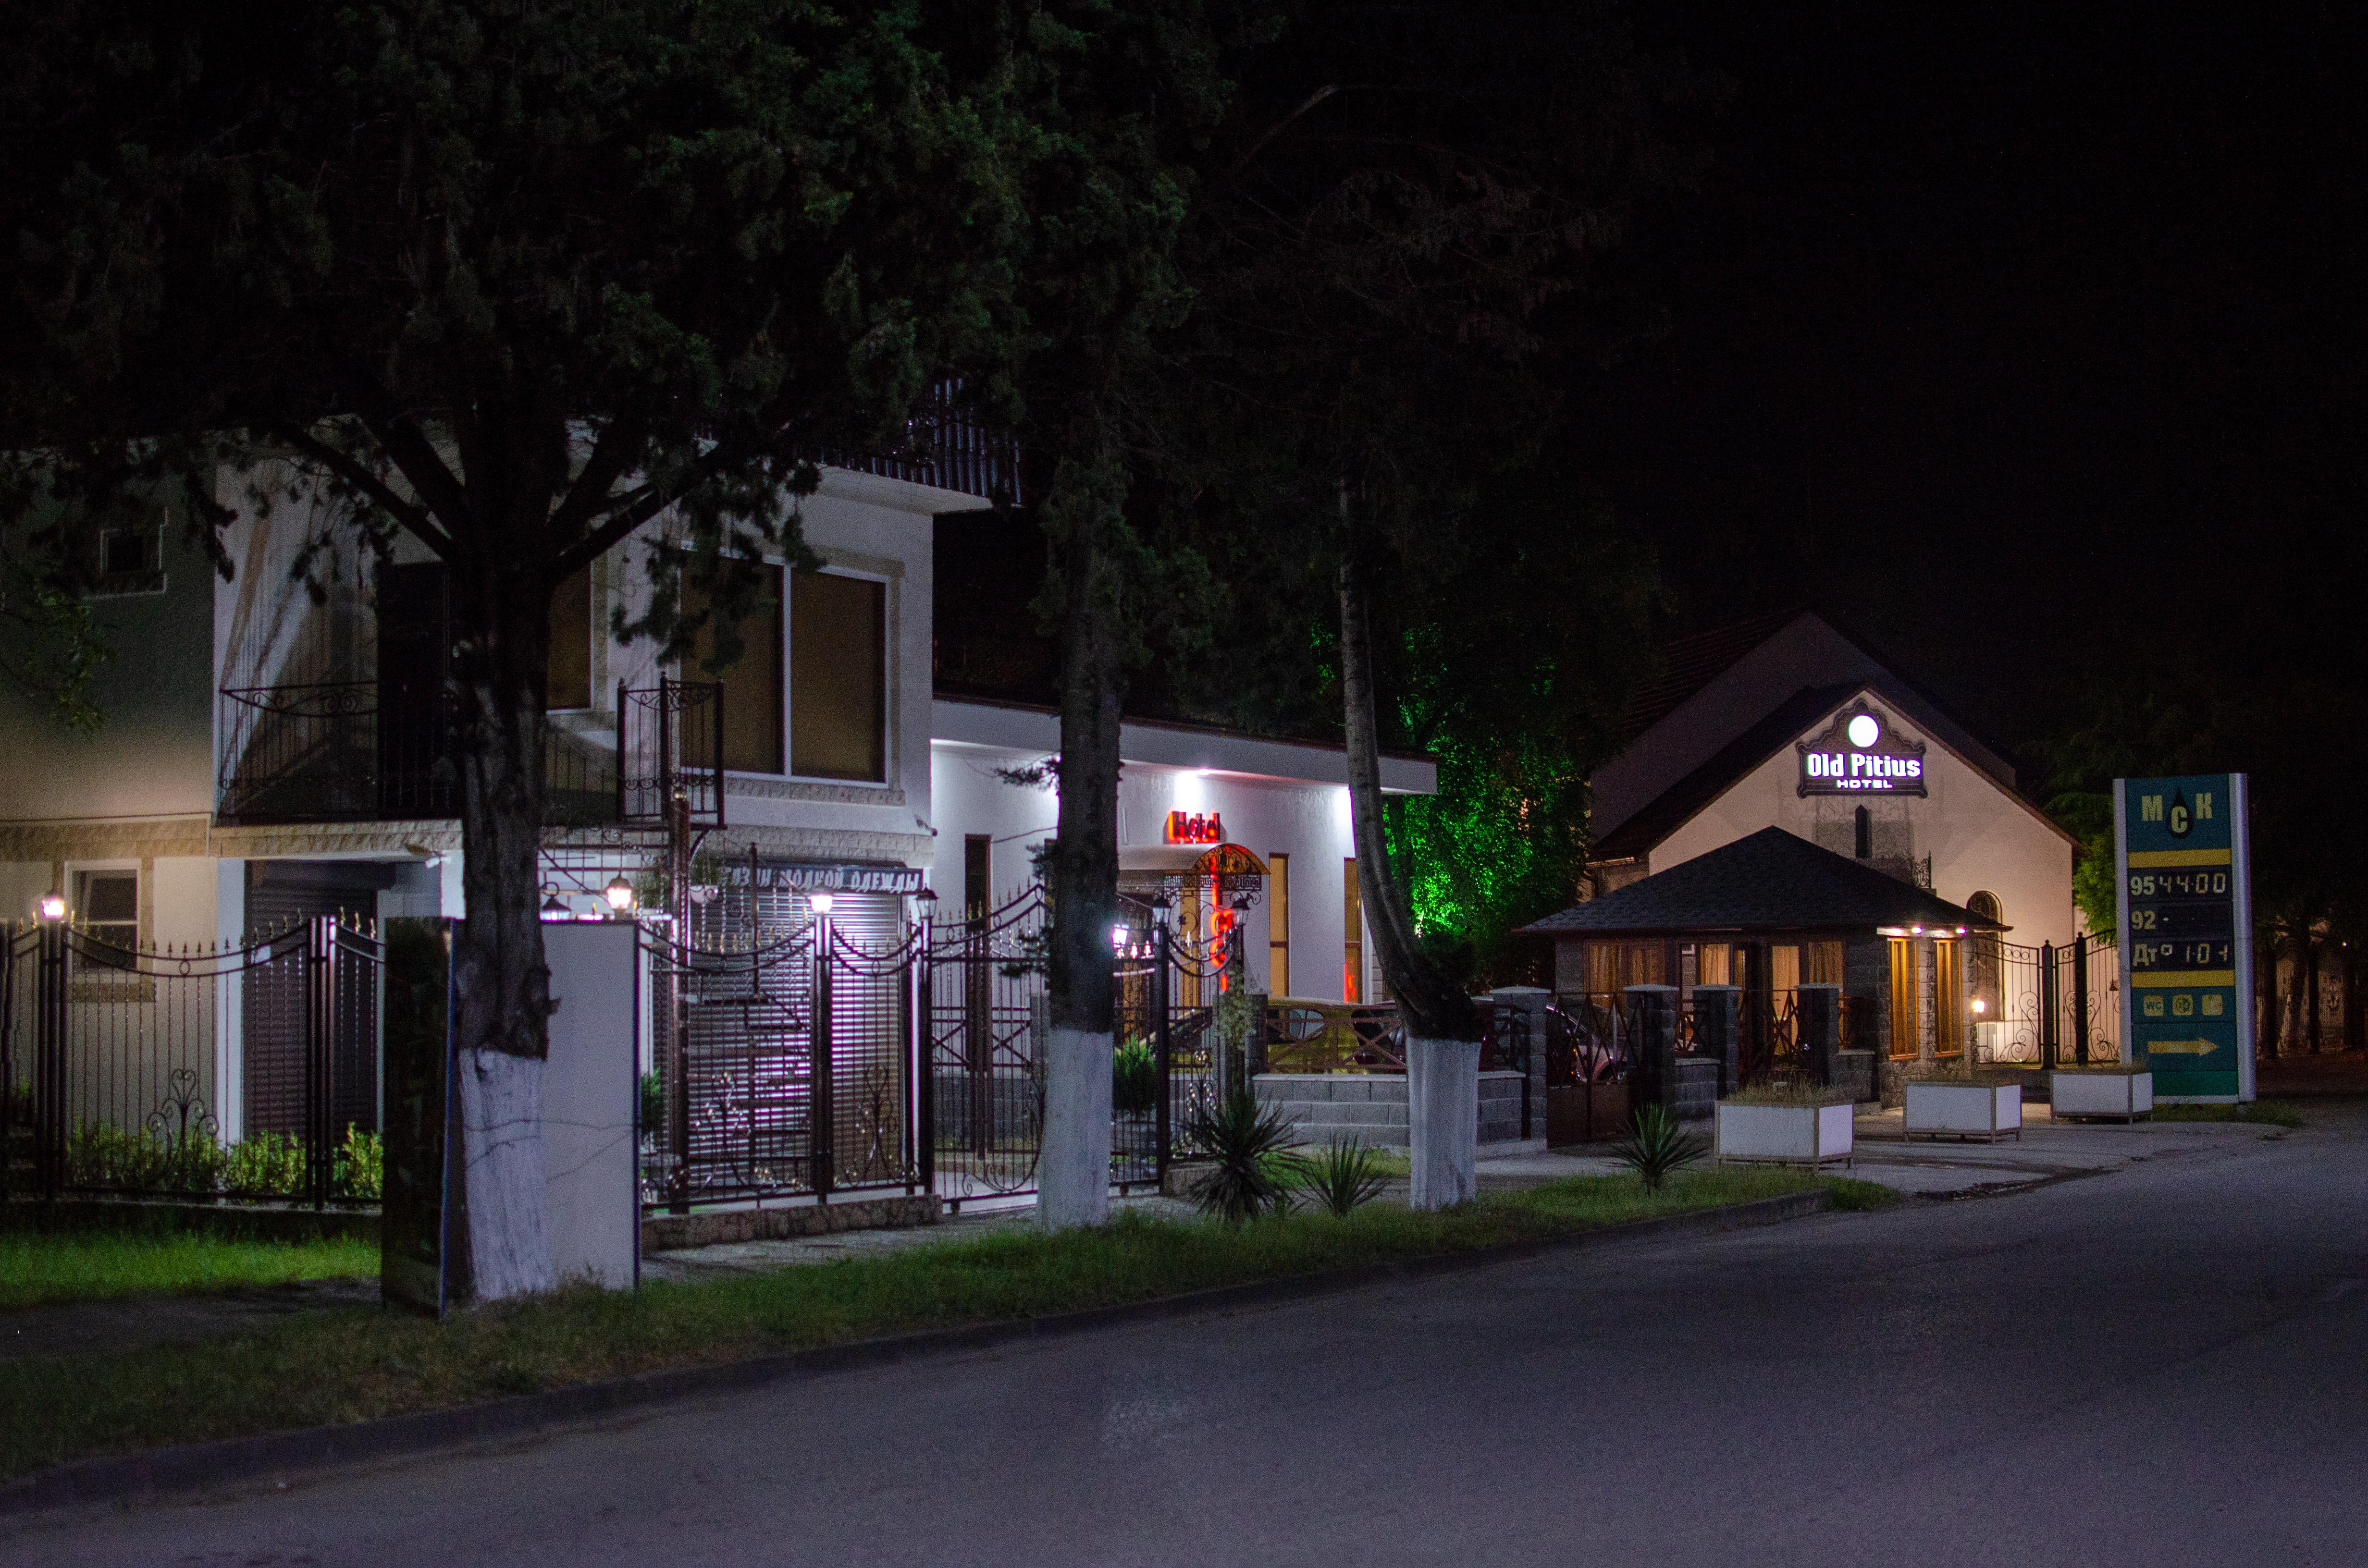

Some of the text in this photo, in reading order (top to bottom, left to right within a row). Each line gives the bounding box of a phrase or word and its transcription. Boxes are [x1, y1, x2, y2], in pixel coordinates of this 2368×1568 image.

[1807, 753, 1922, 777] Old Pitius
[1837, 779, 1893, 789] HOTEL
[850, 871, 920, 893] ОДЕЖДЫ
[2130, 875, 2156, 896] 95
[2131, 910, 2157, 931] 92
[2132, 943, 2158, 967] Дт
[2146, 1002, 2162, 1010] WC
